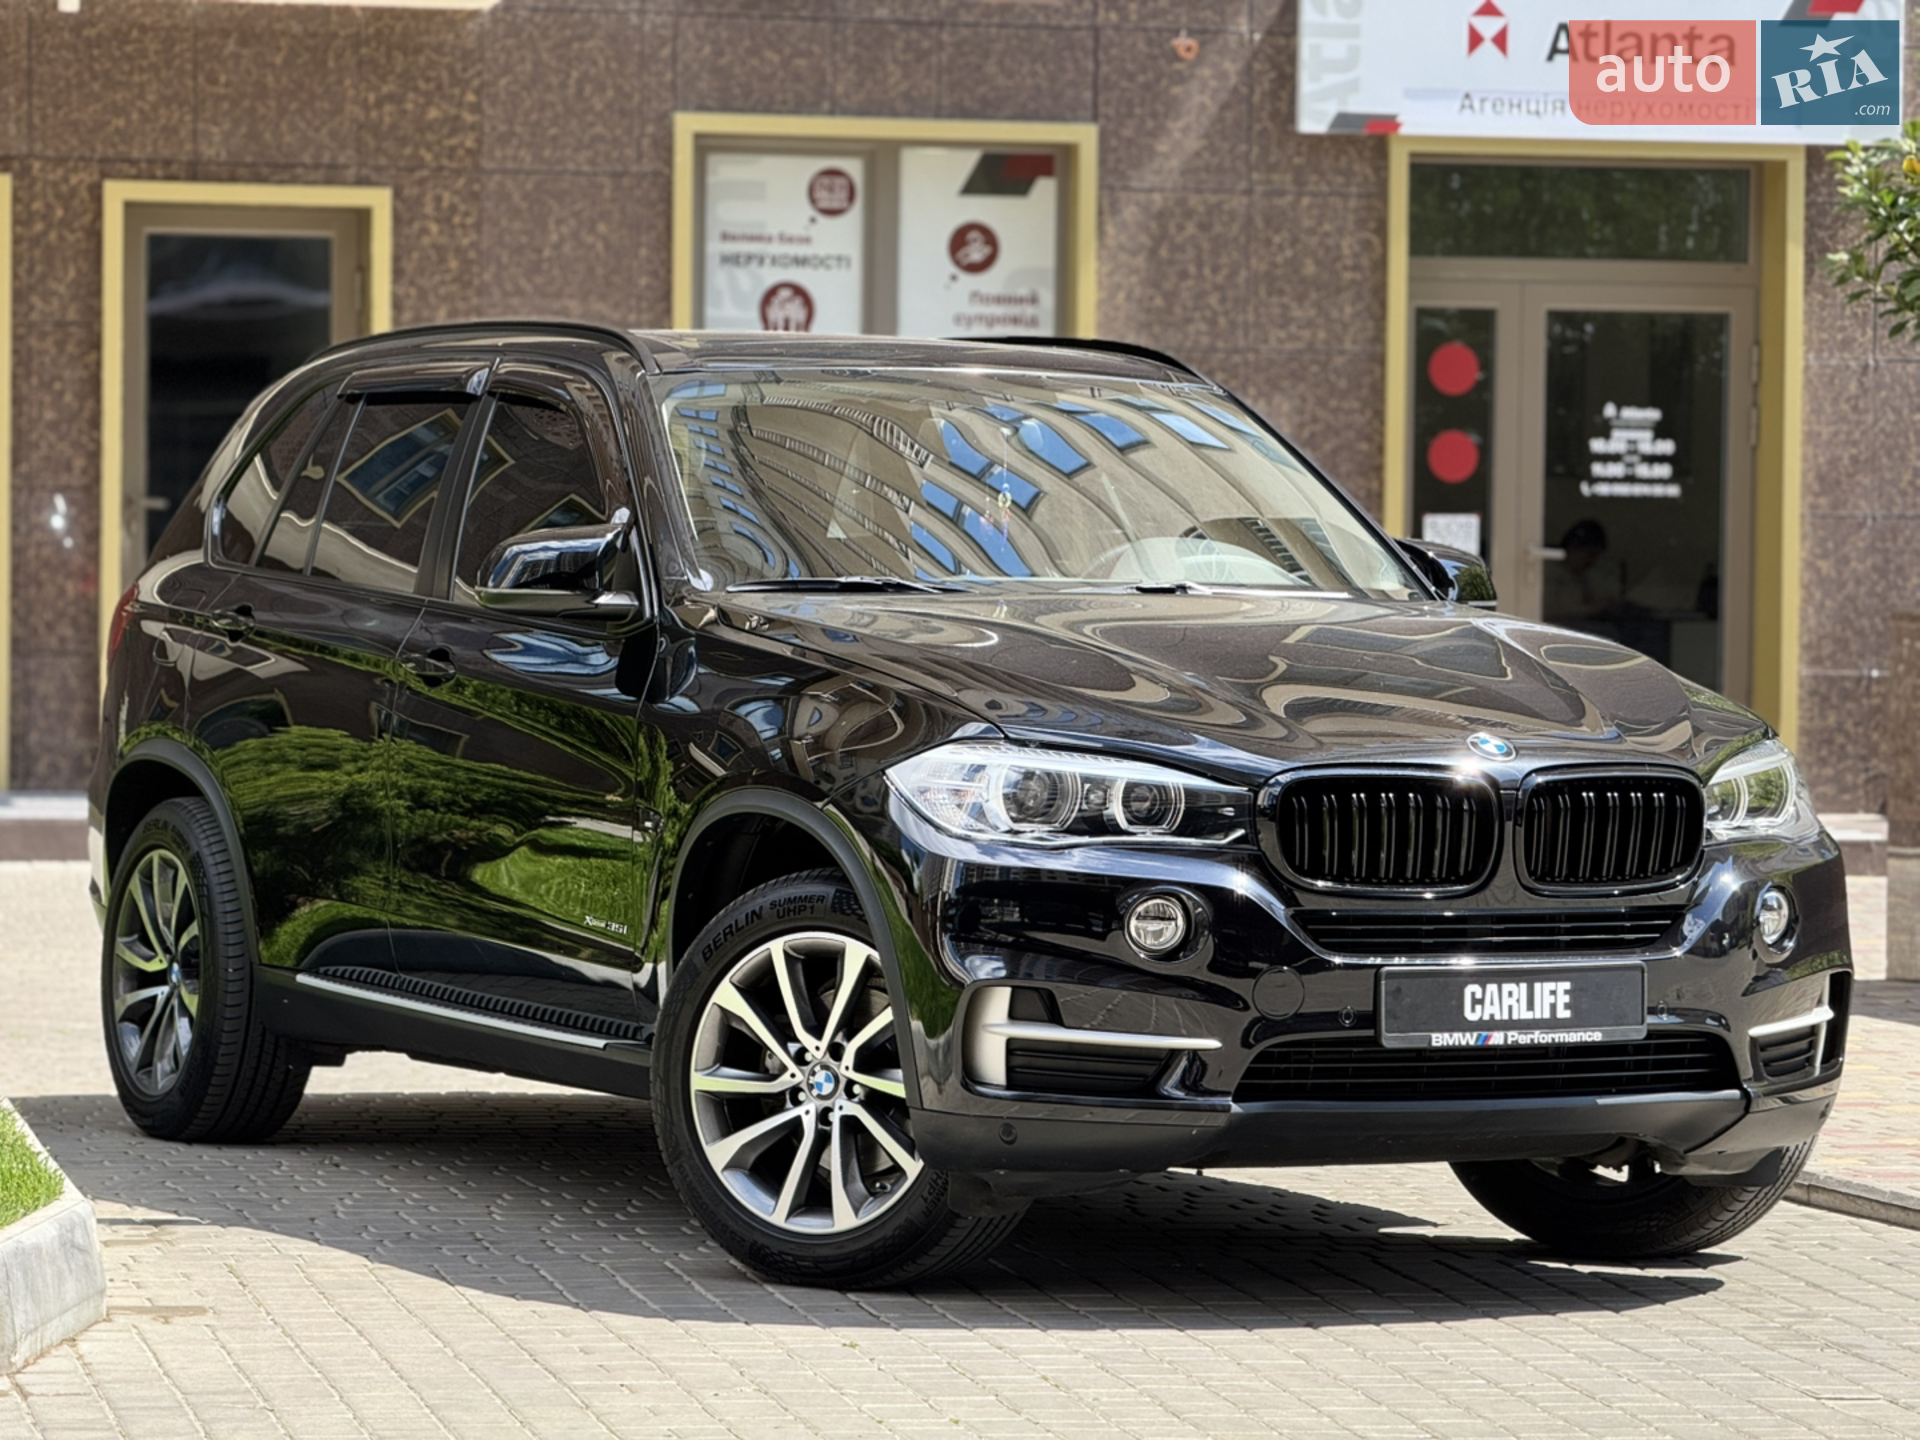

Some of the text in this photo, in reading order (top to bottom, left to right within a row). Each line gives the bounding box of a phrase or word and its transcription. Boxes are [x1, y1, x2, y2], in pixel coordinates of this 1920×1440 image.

[1545, 19, 1737, 67] Atlanta
[1458, 91, 1566, 120] Агенція
[769, 894, 826, 911] SUMMER
[776, 904, 816, 920] UHP1
[701, 905, 764, 963] BERLIN
[1463, 981, 1572, 1022] CARLIFE
[1431, 1032, 1477, 1046] BMW
[1507, 1030, 1603, 1045] Performance
